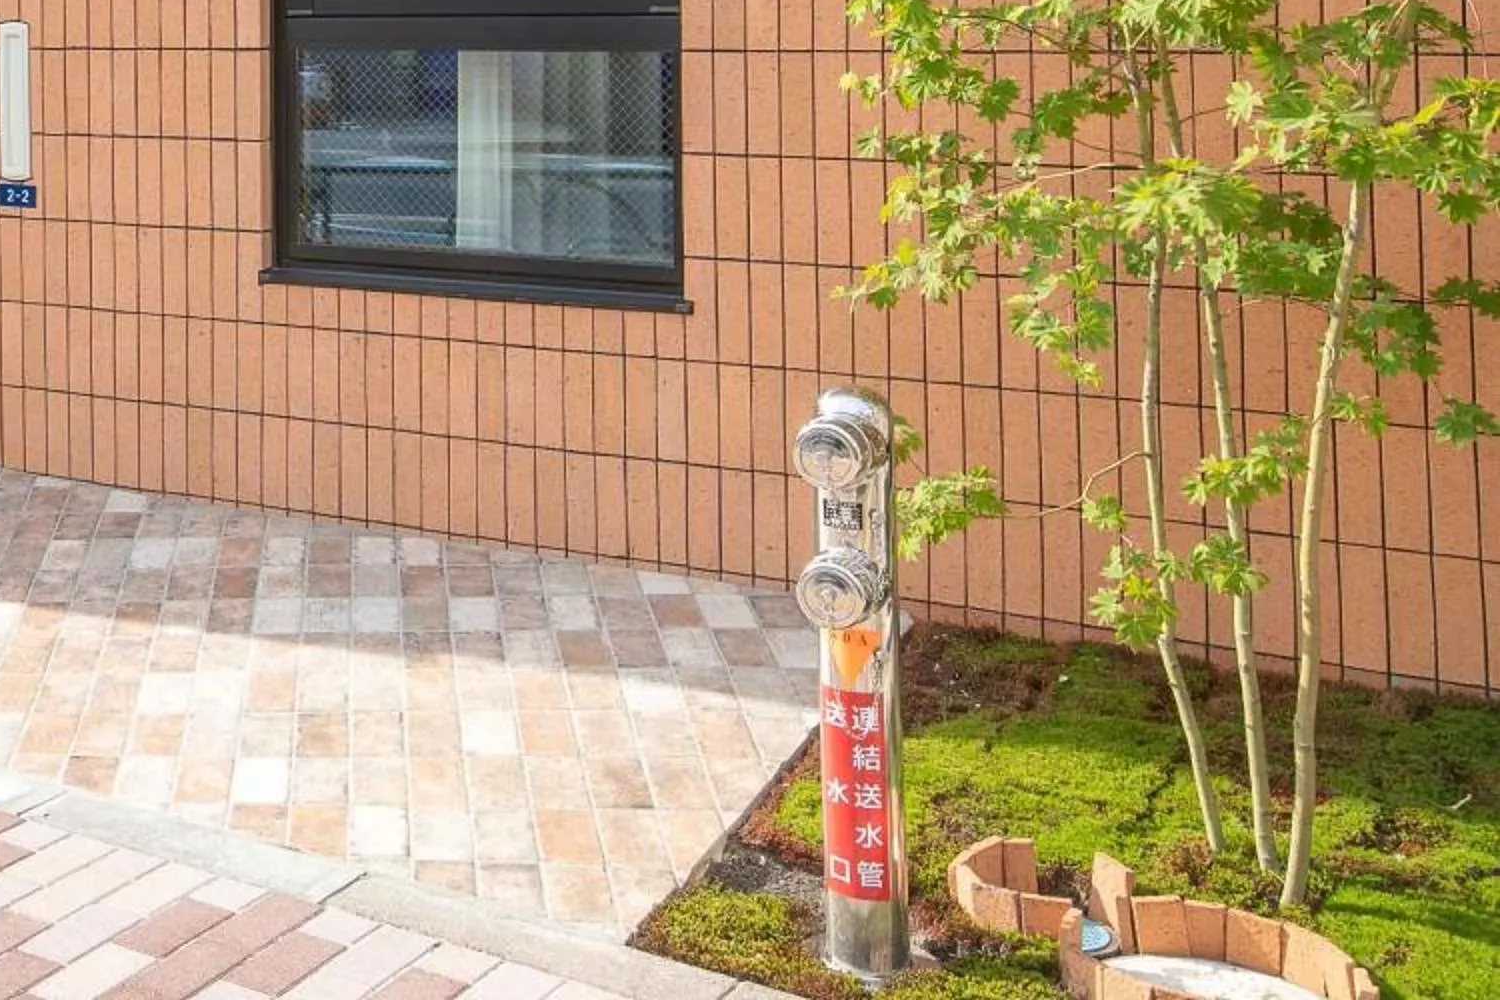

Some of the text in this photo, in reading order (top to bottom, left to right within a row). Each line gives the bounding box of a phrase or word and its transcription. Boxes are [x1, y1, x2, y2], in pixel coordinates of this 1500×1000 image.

[6, 188, 29, 203] 2-2
[823, 698, 851, 885] 送水口
[851, 704, 884, 889] 連結送水管
